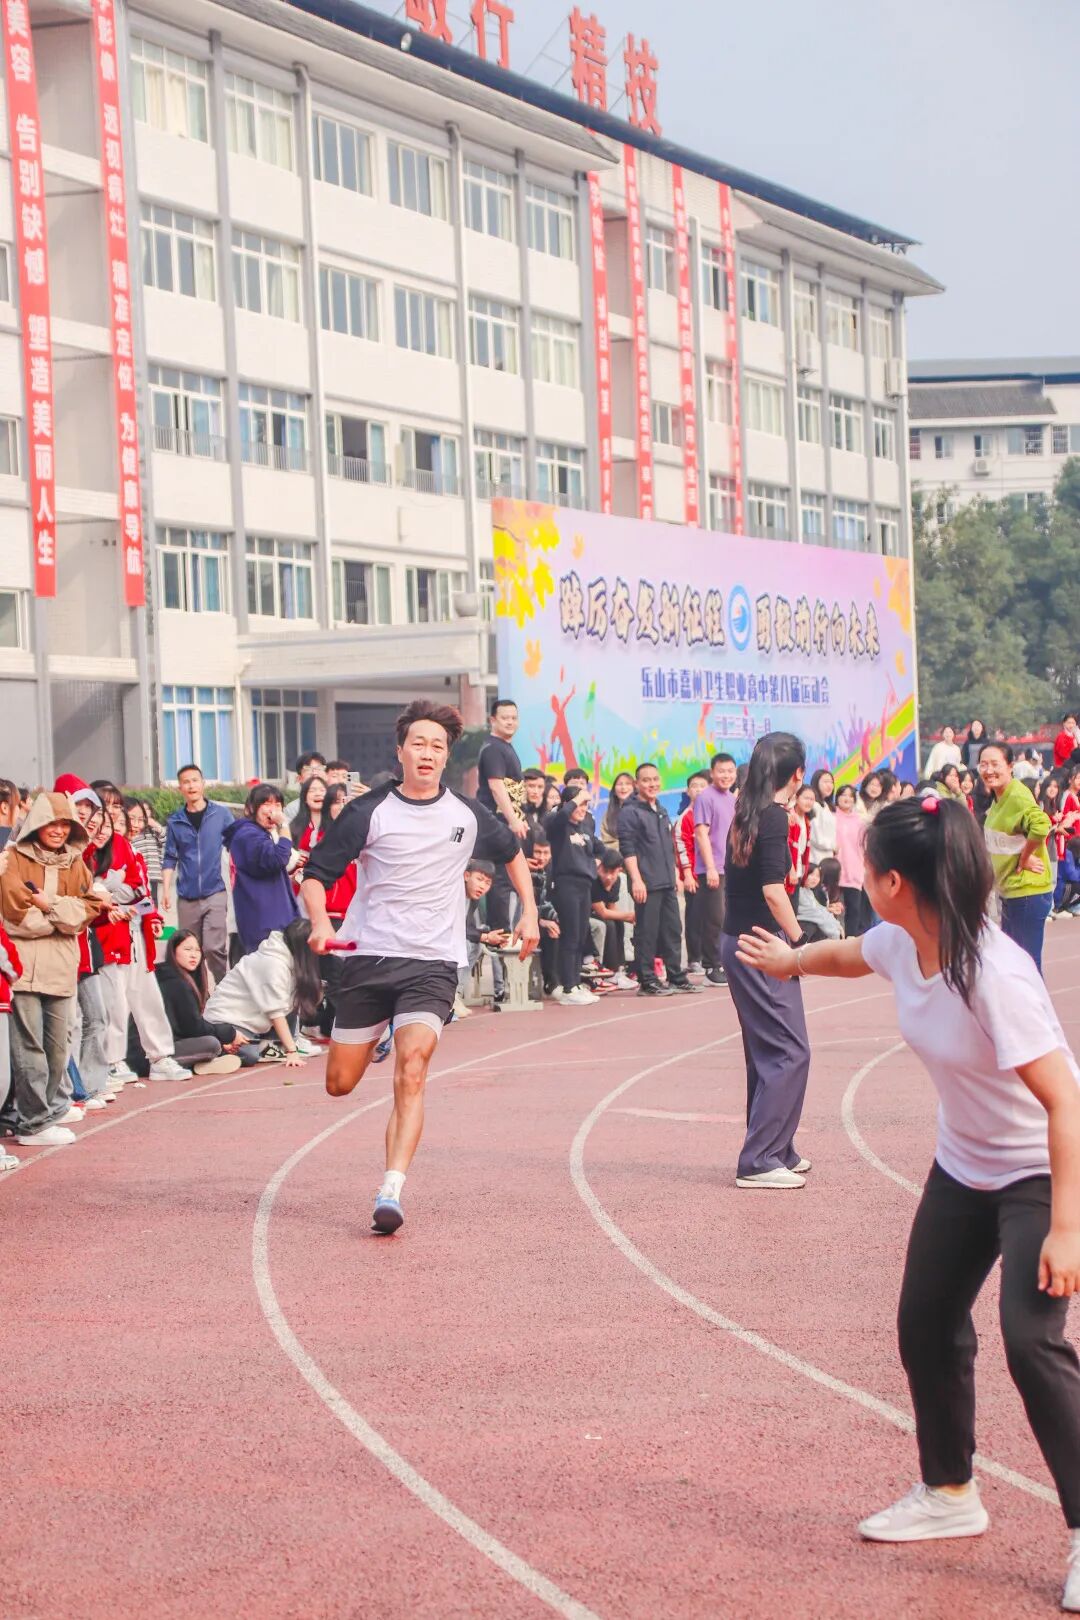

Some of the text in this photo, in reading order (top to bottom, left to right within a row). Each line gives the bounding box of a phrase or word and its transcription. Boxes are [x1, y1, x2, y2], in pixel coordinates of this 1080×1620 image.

[569, 5, 662, 138] 精技
[16, 113, 46, 286] 告别缺憾
[28, 314, 54, 566] 塑造美丽人生
[120, 411, 142, 575] 为健康导航
